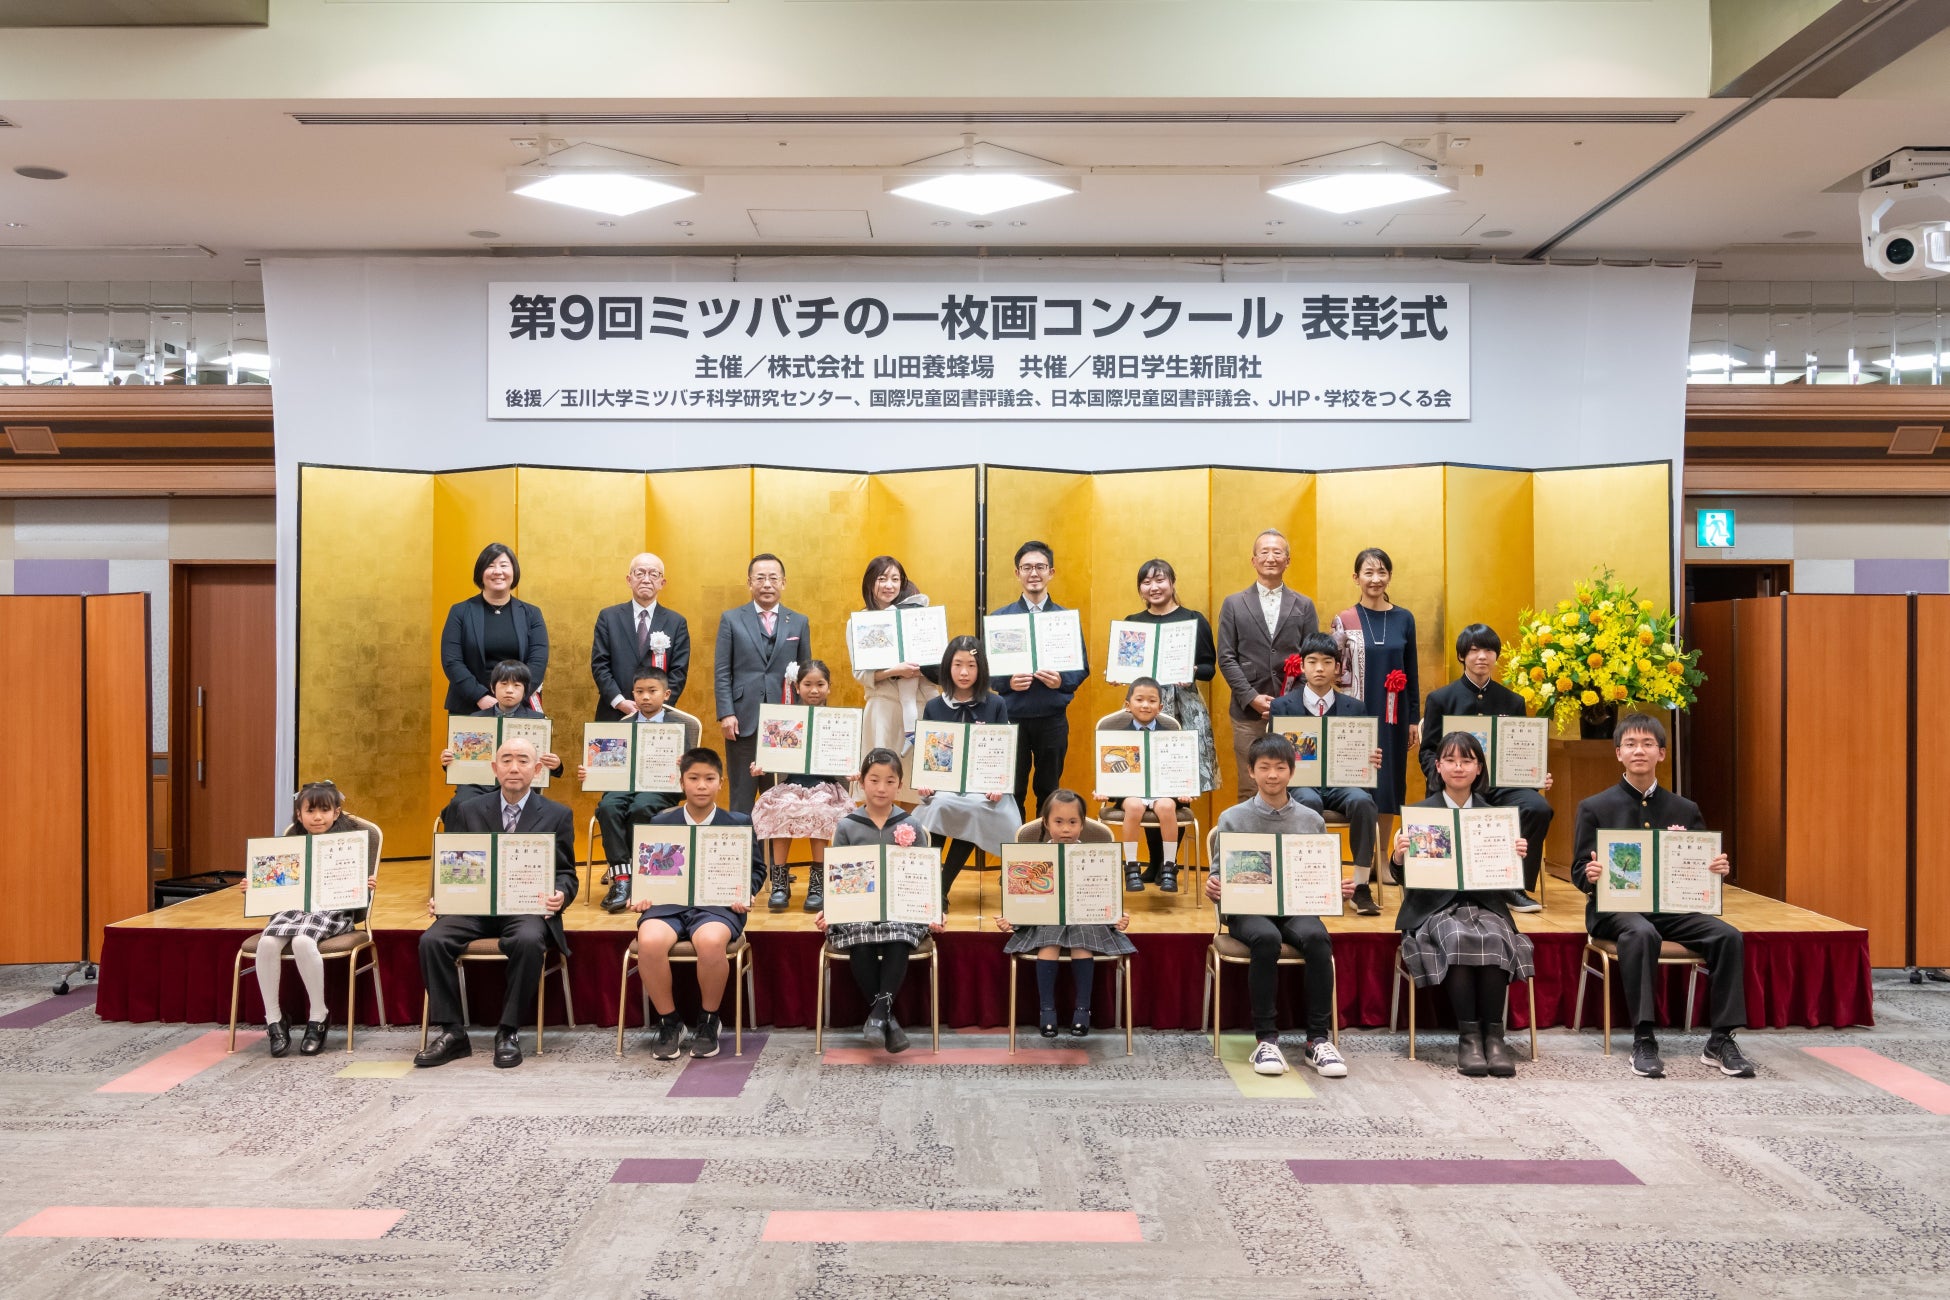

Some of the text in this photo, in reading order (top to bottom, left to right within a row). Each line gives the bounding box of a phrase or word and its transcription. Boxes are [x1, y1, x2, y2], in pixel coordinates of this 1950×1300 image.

[508, 293, 1449, 342] 第9回ミツバチの一枚画コンクール 表彰式
[694, 354, 1263, 379] 主催／株式会社 山田養蜂場 共催／朝日学生新聞社
